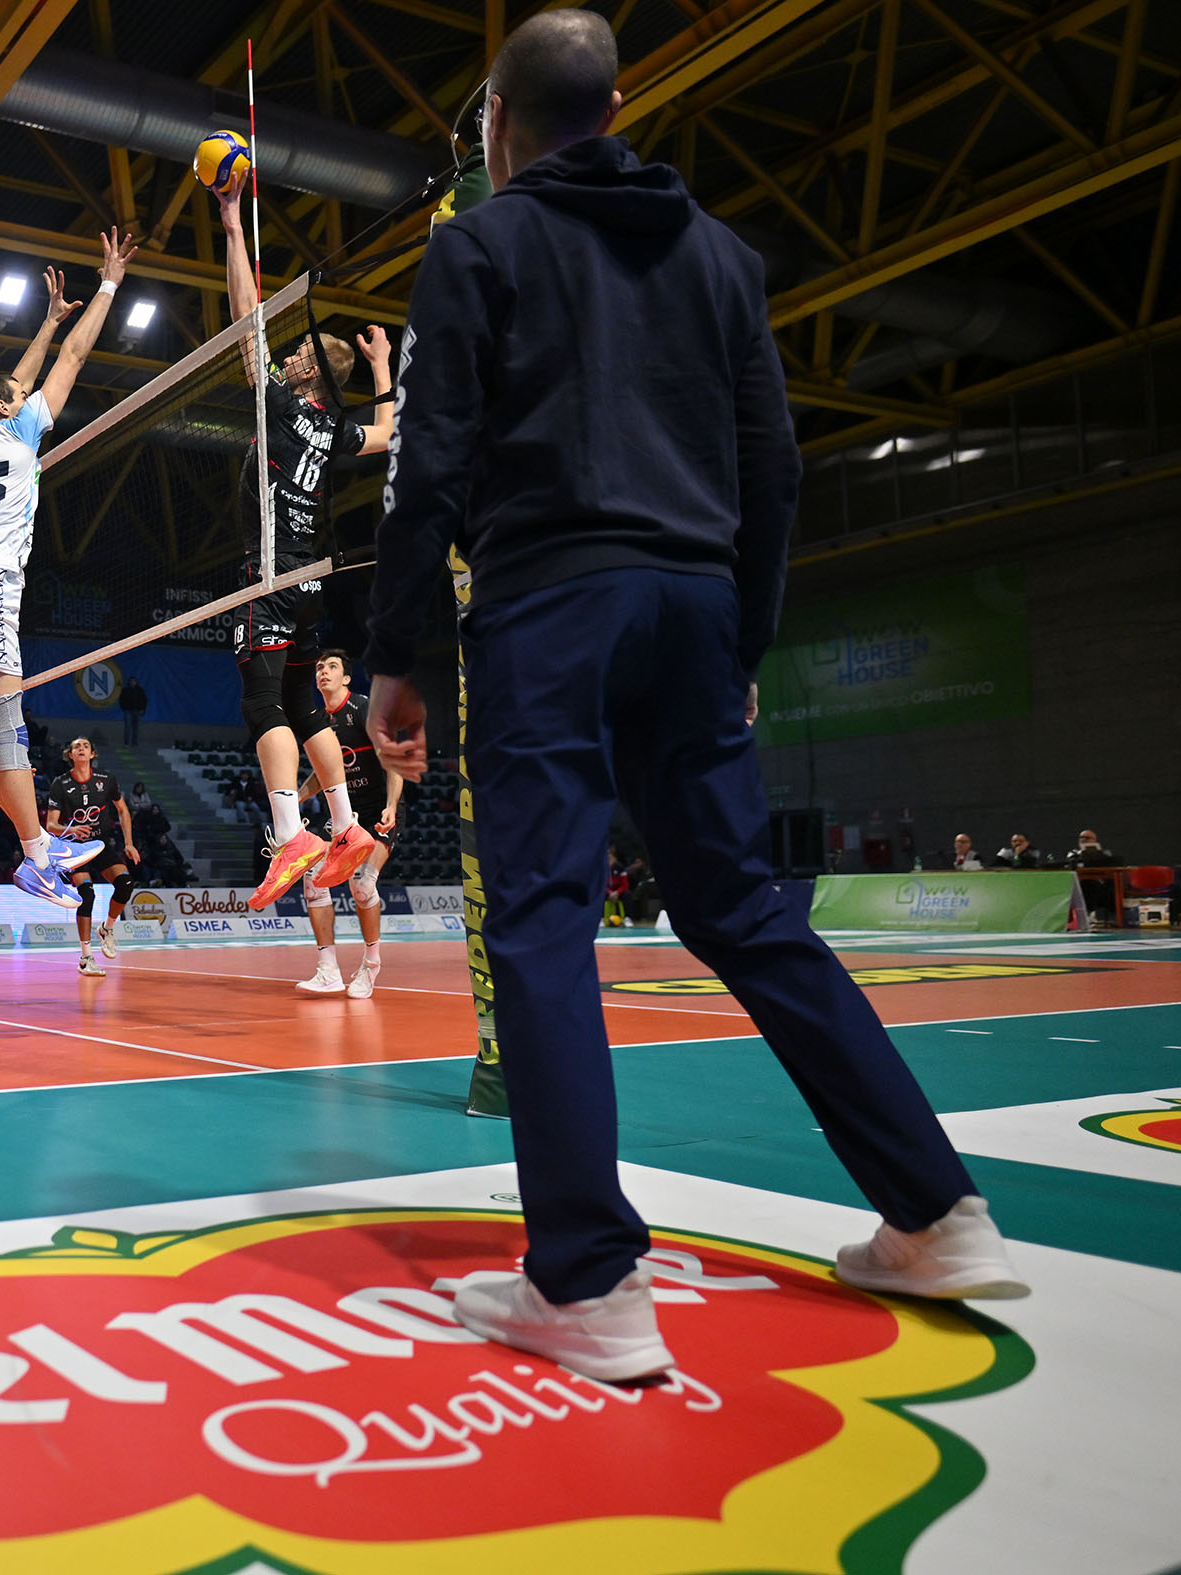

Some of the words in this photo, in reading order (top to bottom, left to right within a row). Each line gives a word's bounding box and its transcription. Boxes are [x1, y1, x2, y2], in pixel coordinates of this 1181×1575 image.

[165, 587, 214, 602] INFISSI
[169, 626, 227, 643] ERMICO
[234, 624, 245, 646] 18
[853, 635, 931, 665] GREEN
[838, 659, 914, 686] HOUSE
[922, 896, 970, 908] GREEN
[910, 906, 956, 919] HOUSE
[184, 920, 232, 932] ISMEA
[248, 918, 295, 930] ISMEA
[105, 1246, 780, 1386] Moe
